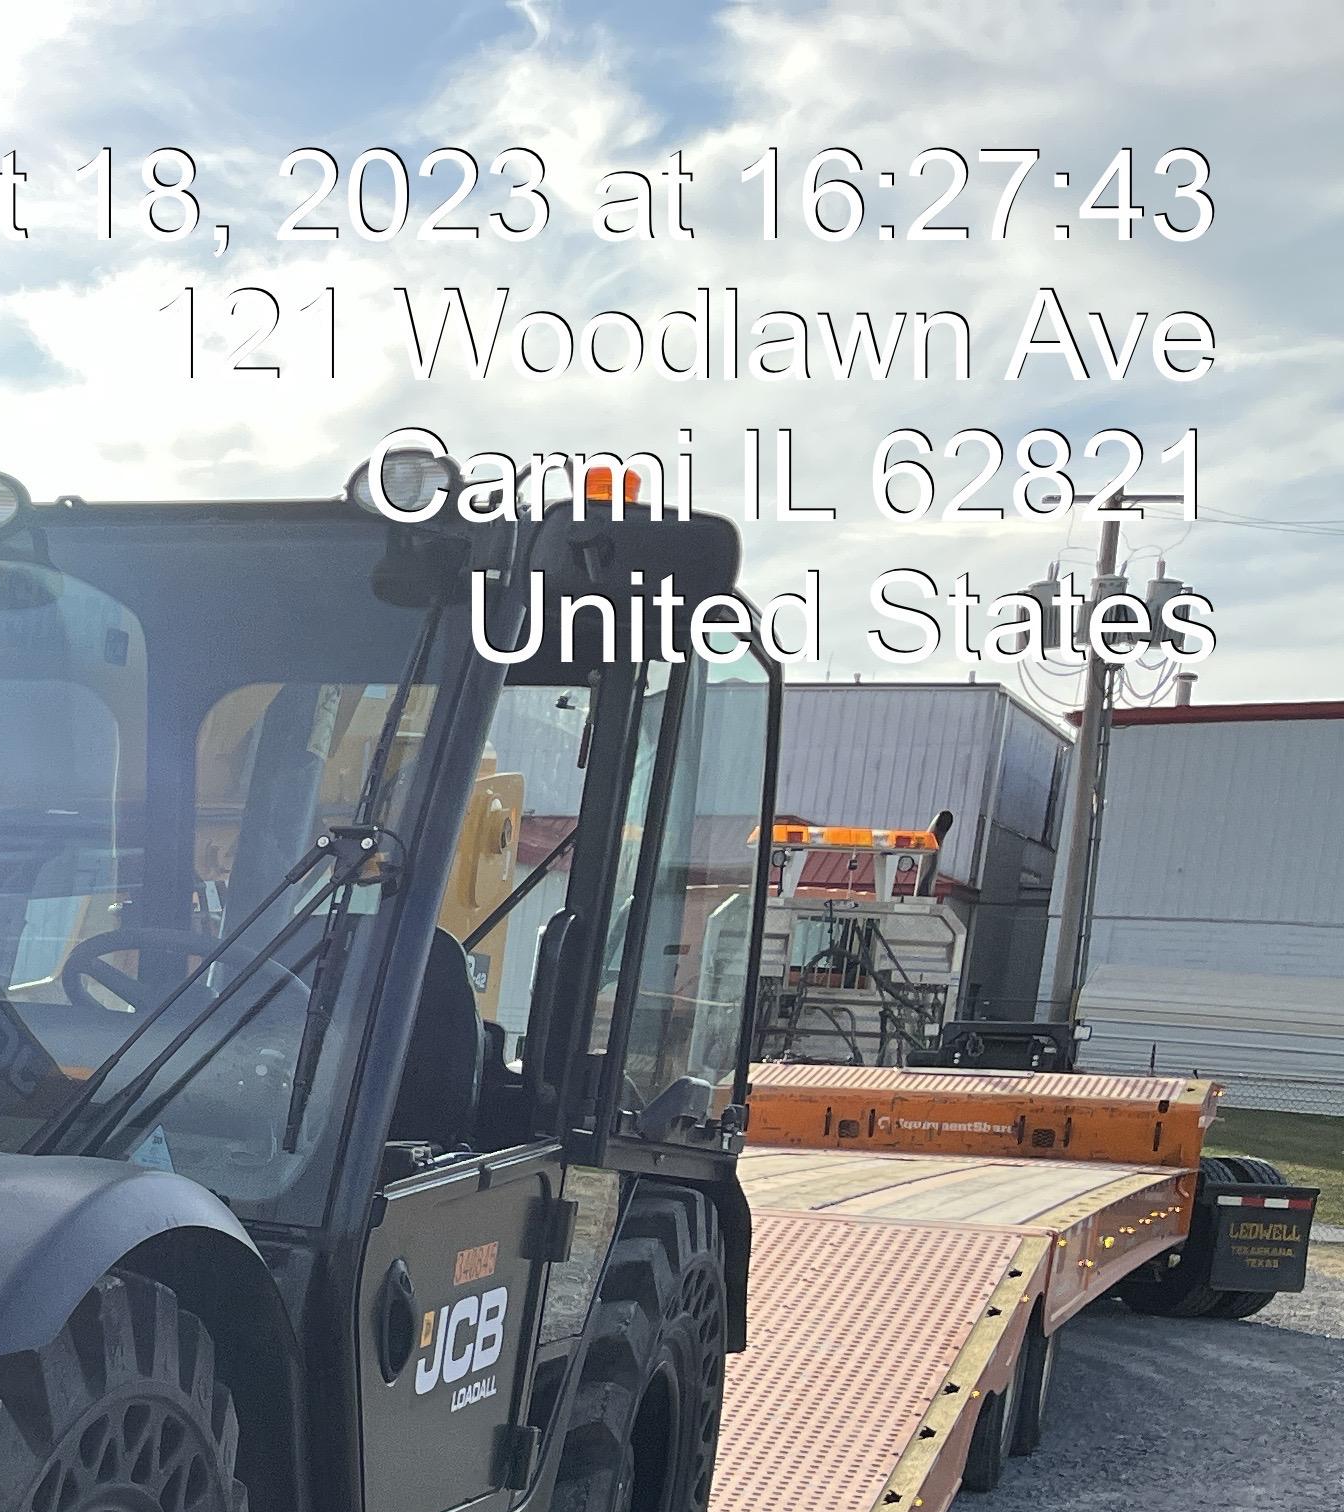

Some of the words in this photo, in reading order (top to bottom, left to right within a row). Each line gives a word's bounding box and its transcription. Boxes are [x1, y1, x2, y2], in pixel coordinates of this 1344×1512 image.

[1229, 1222, 1301, 1242] LEDWELL
[415, 1286, 508, 1395] JCB
[450, 1374, 497, 1412] LOADALL
